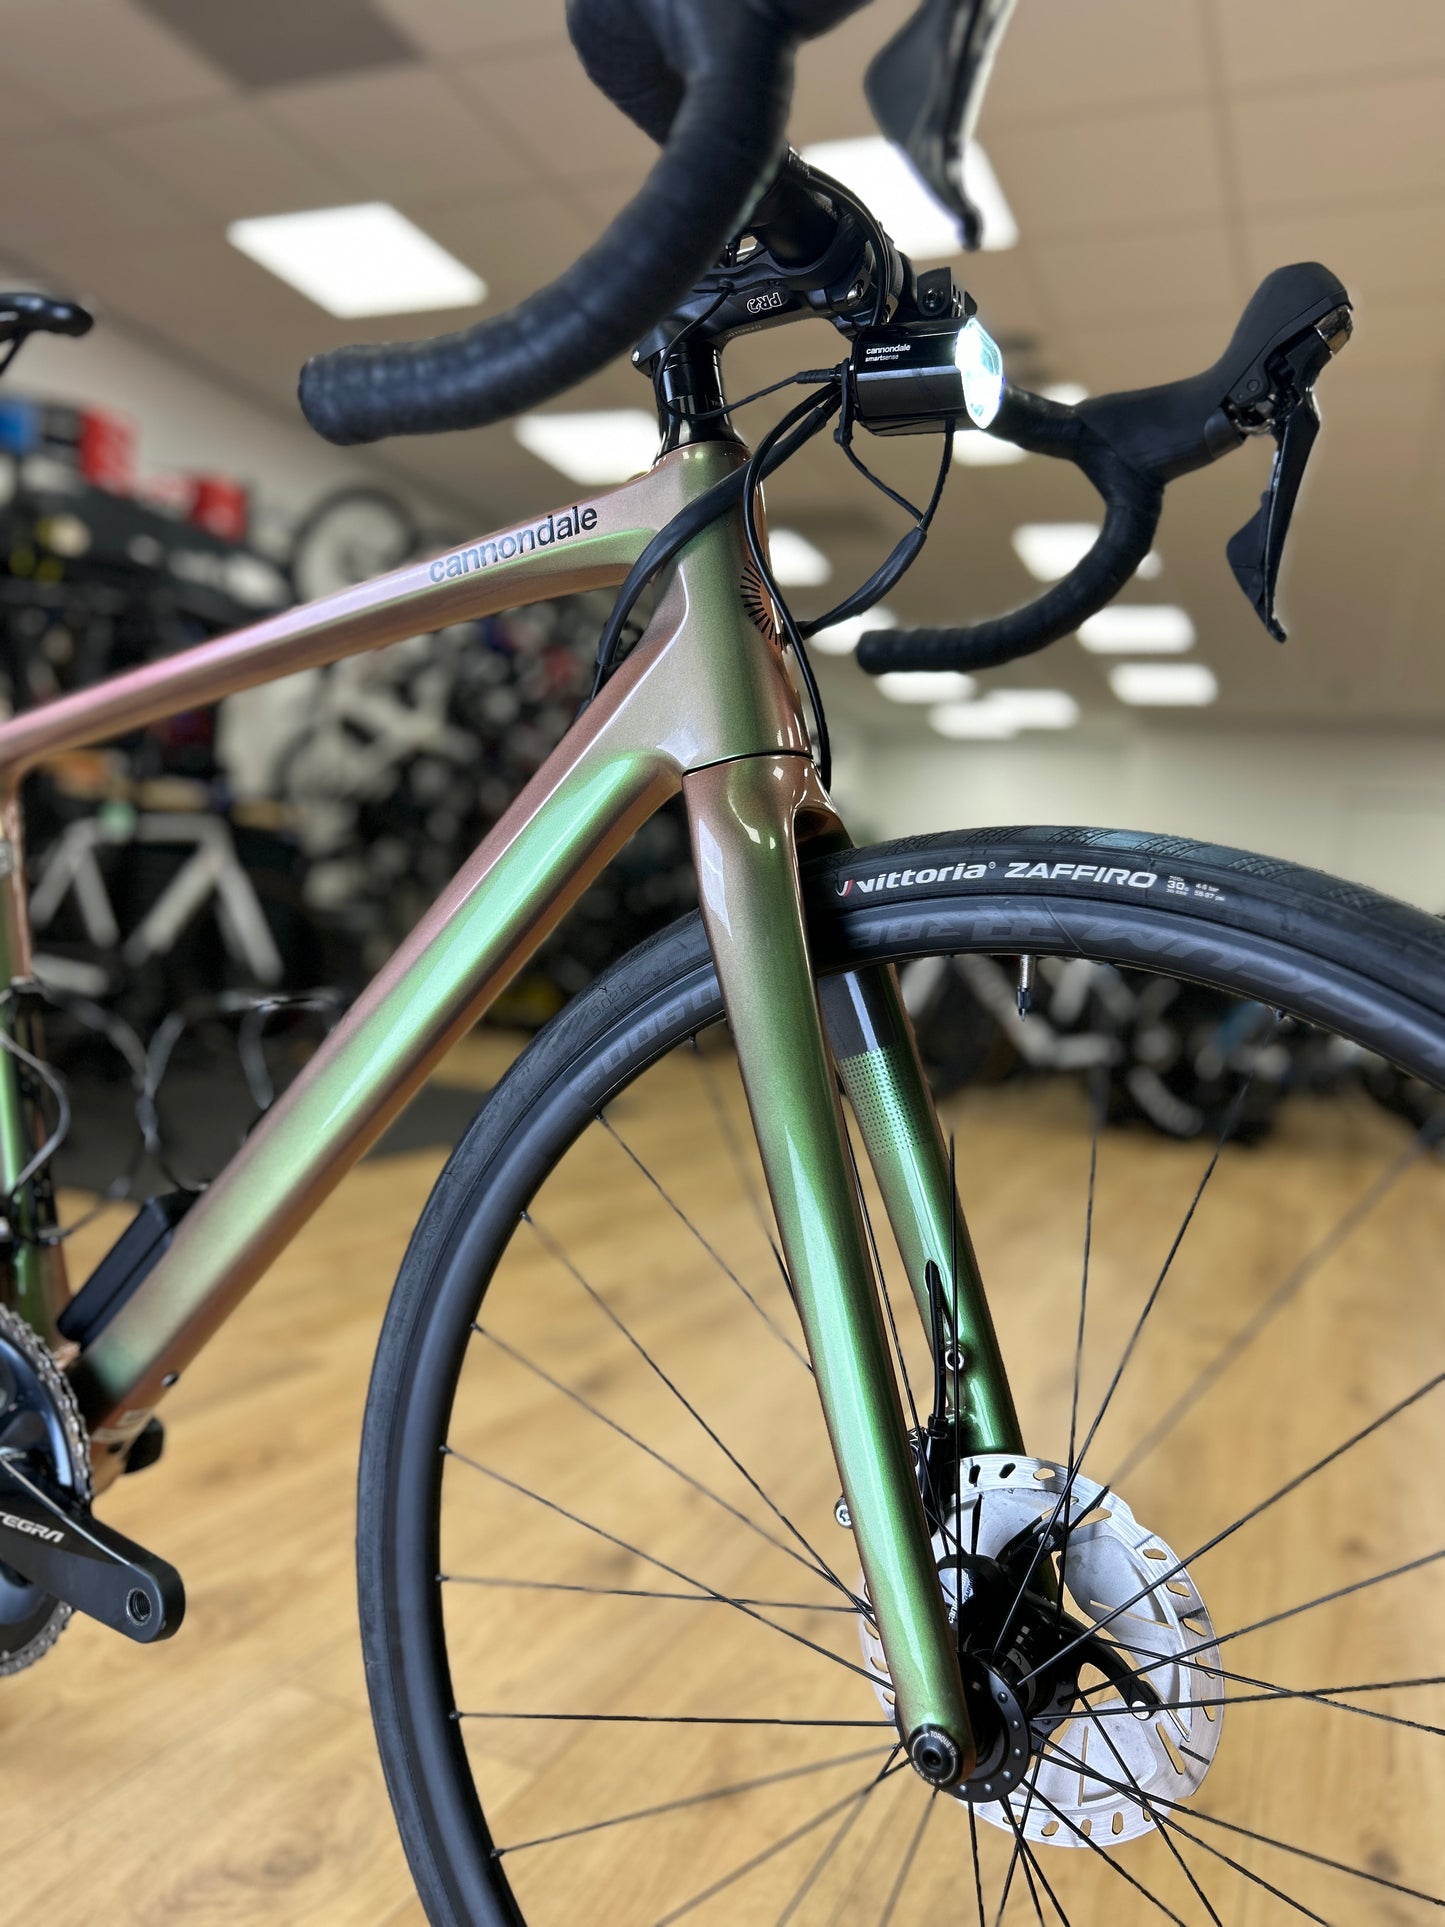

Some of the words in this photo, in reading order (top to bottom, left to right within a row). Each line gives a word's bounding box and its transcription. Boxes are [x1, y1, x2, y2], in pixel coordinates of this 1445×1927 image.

[746, 292, 783, 314] PRO
[866, 344, 911, 354] cannondale
[429, 505, 598, 583] cannondale
[1003, 862, 1158, 889] ZAFFIRO
[930, 1730, 952, 1749] TORQUE
[949, 1747, 957, 1756] TO
